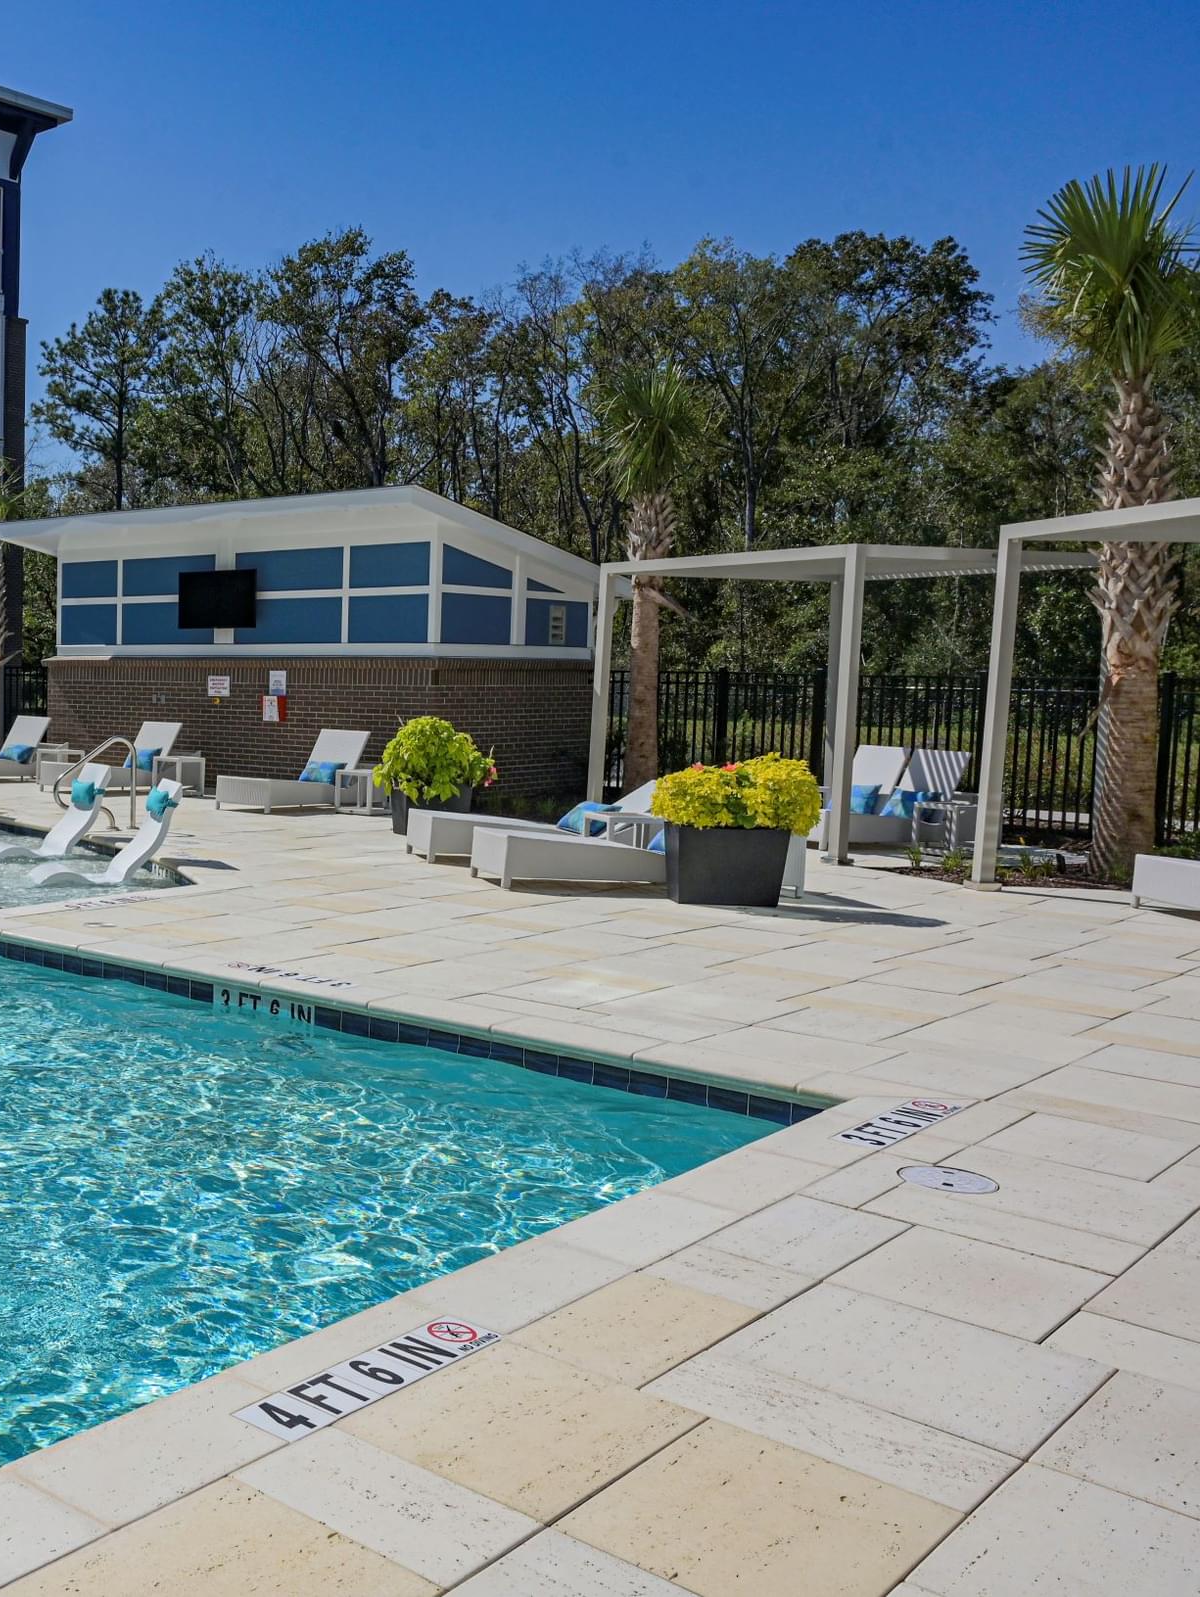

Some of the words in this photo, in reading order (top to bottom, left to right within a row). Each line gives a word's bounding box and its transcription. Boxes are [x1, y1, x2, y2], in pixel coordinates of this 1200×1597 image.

[239, 991, 261, 1011] FT
[290, 1003, 312, 1024] IN
[878, 1116, 922, 1128] 6
[890, 1106, 944, 1123] IN
[841, 1134, 886, 1146] 3
[853, 1122, 908, 1140] FT
[377, 1336, 459, 1371] IN
[349, 1360, 404, 1385] 6
[287, 1373, 370, 1415] FT
[258, 1402, 317, 1429] 4
